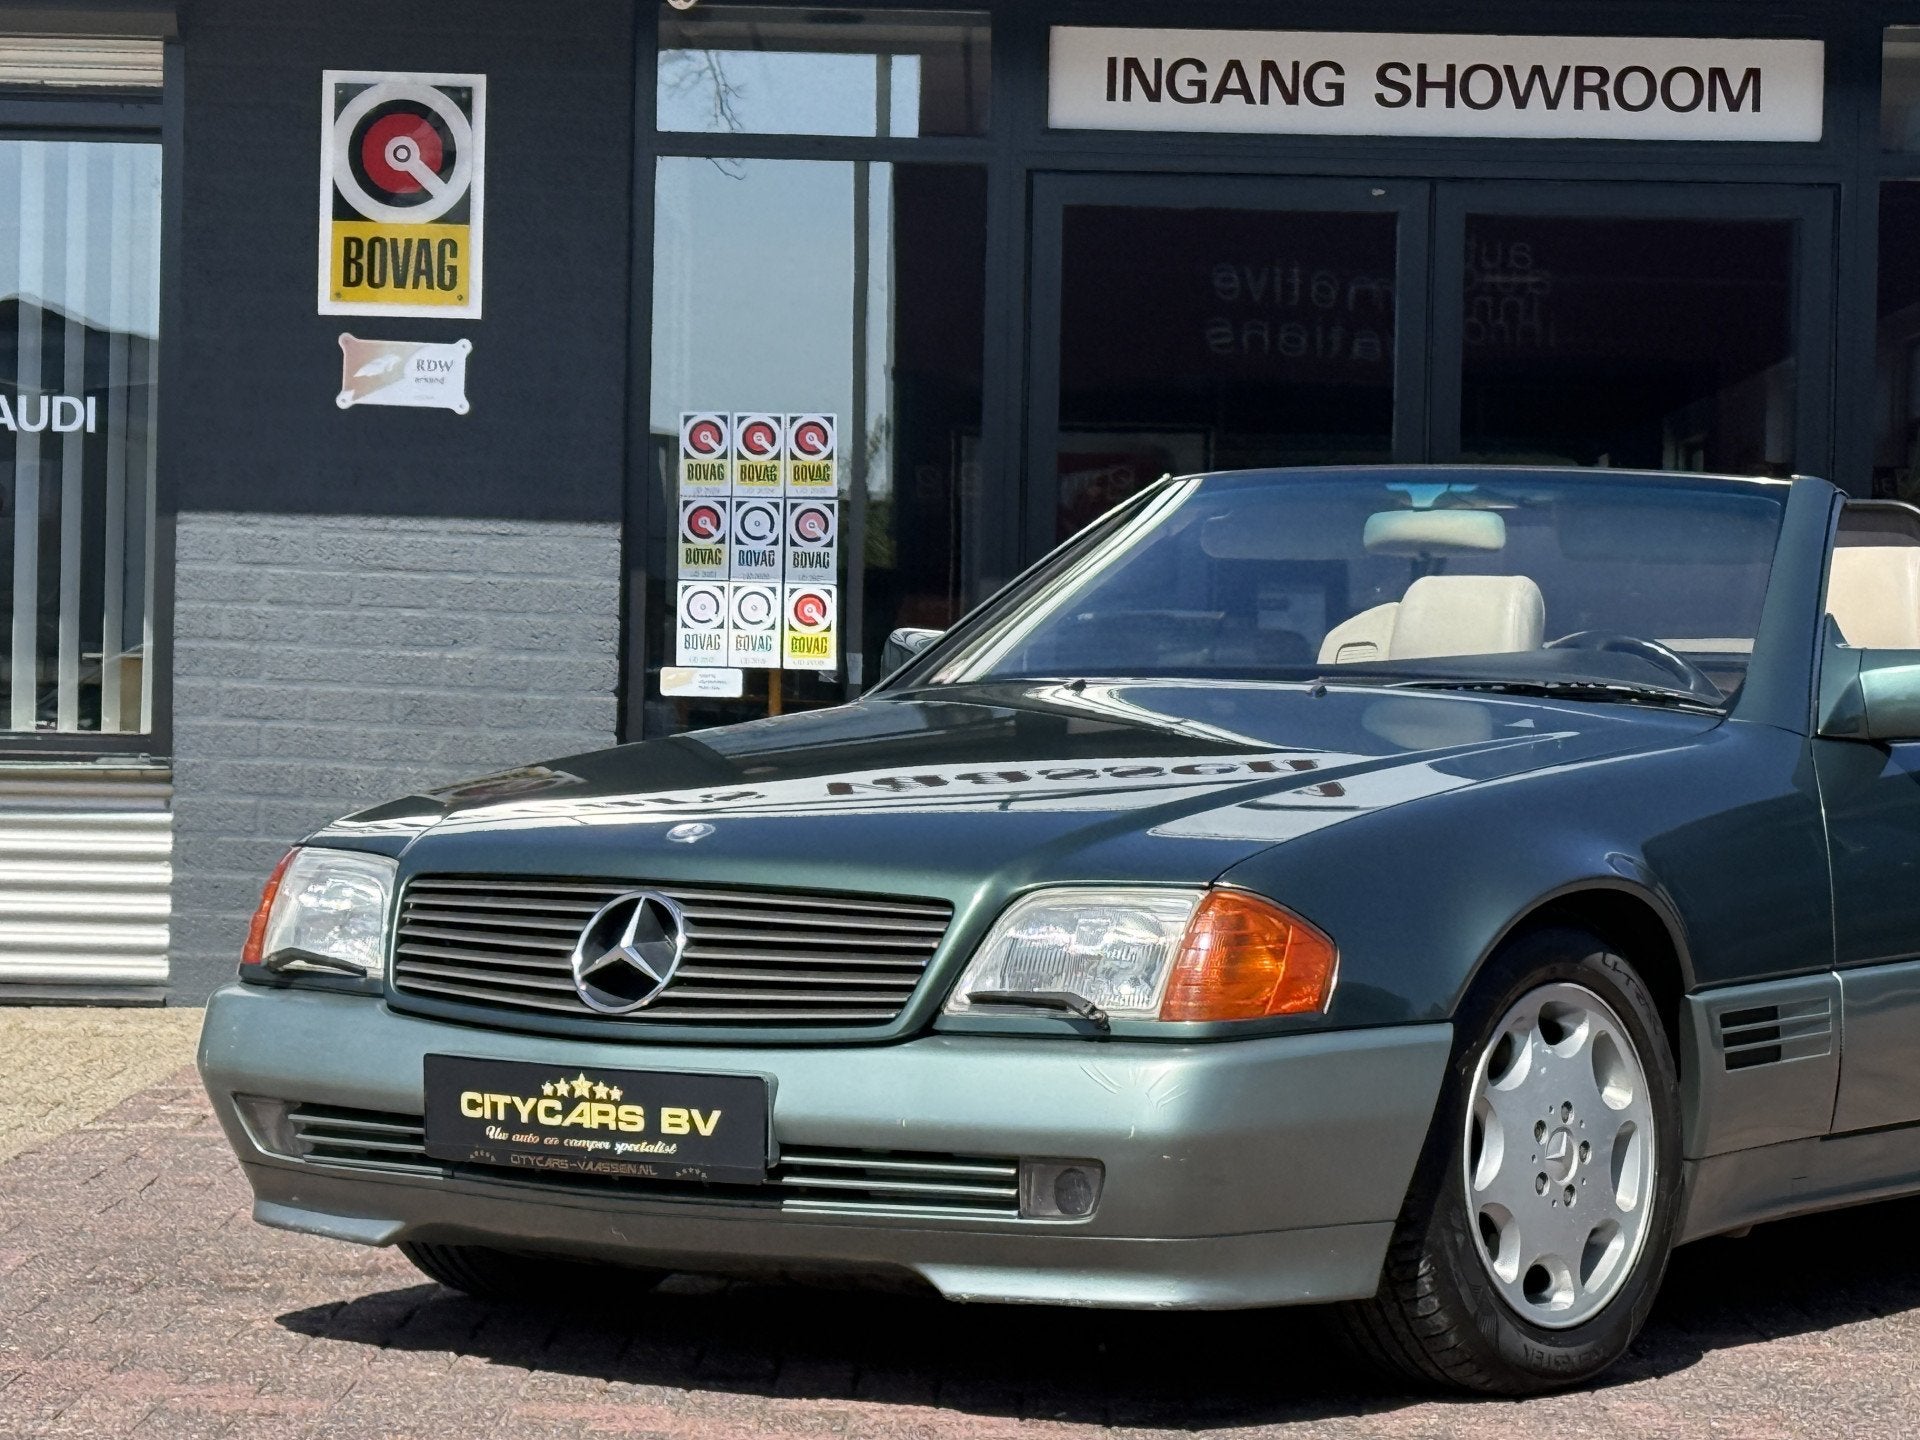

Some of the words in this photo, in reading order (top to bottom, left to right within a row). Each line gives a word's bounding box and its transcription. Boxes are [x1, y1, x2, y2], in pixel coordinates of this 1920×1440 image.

[1106, 56, 1345, 108] INGANG
[1374, 61, 1762, 114] SHOWROOM
[342, 236, 458, 291] BOVAG
[416, 358, 454, 372] RDW
[0, 394, 96, 433] AUDI
[687, 463, 725, 482] BOVAG
[740, 463, 778, 483] BOVAG
[793, 464, 831, 483] BOVAG
[685, 548, 722, 566] BOVAG
[738, 549, 776, 568] BOVAG
[792, 550, 830, 569] BOVAG
[683, 633, 721, 651] BOVAG
[735, 634, 773, 652] BOVAG
[790, 636, 829, 655] BOVAG
[460, 1091, 645, 1133] CITYCARS
[660, 1106, 722, 1137] BV
[485, 1125, 509, 1141] Uw
[511, 1132, 539, 1144] auto
[563, 1138, 611, 1151] camper
[614, 1140, 677, 1155] specialist
